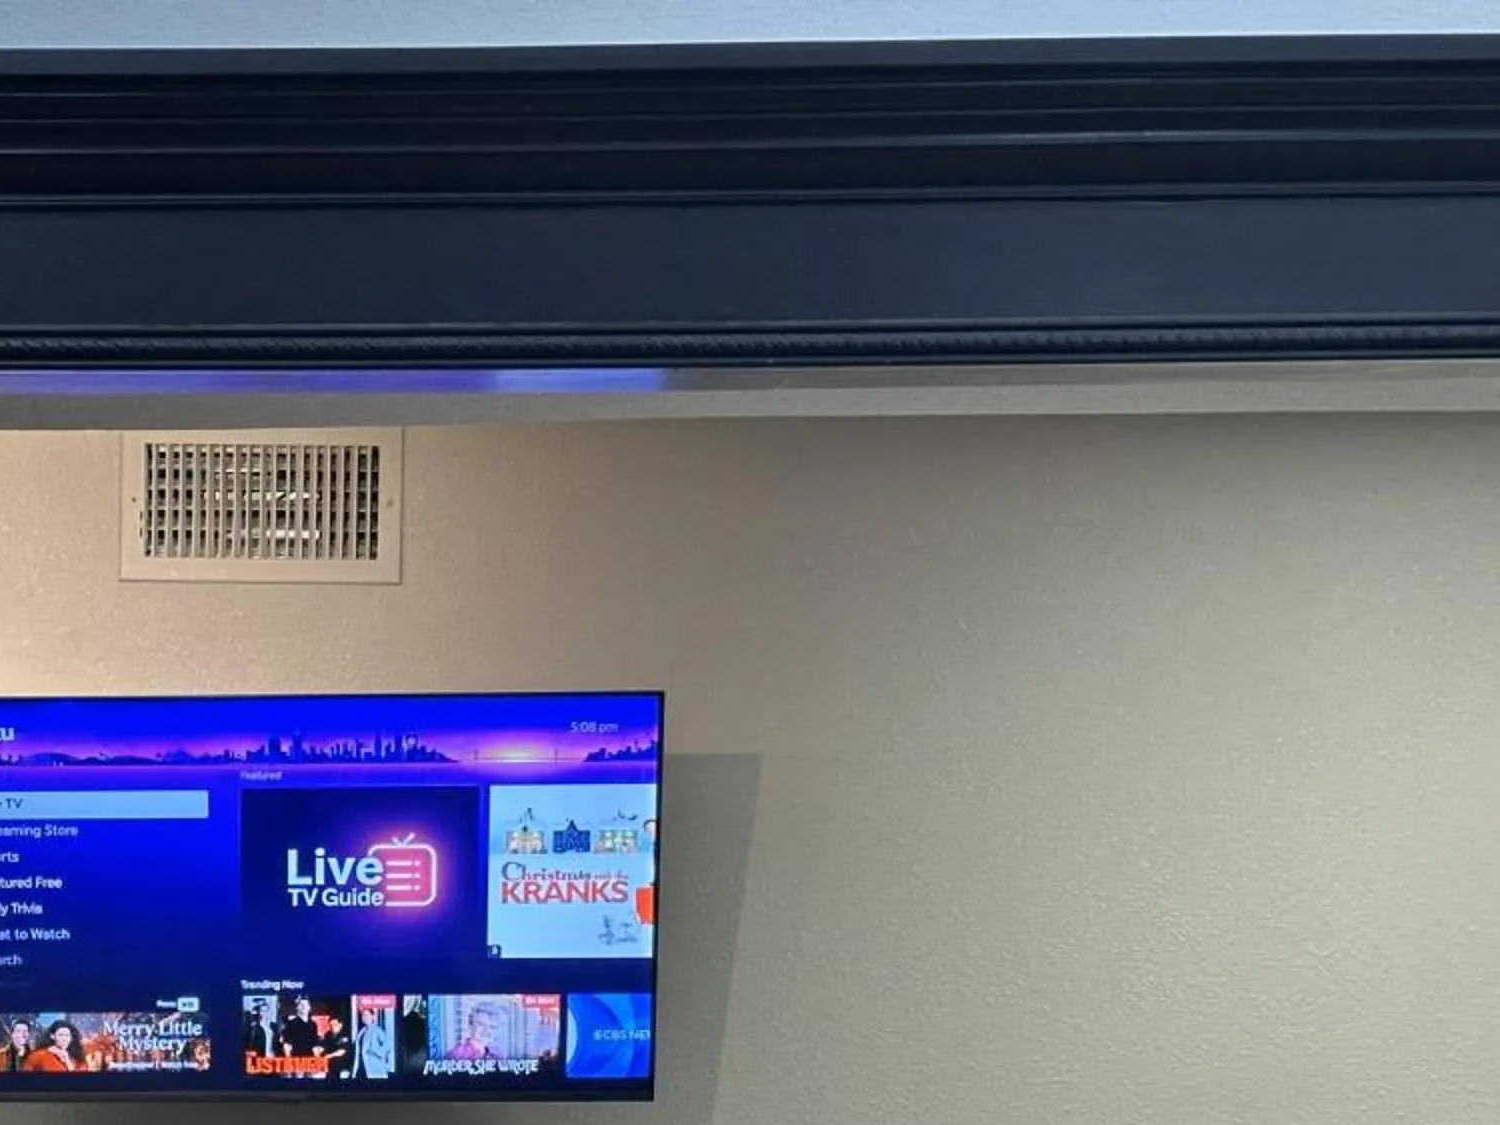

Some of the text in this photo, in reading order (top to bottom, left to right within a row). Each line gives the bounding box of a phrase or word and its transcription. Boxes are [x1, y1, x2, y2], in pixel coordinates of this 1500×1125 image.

[599, 723, 619, 734] pm
[6, 798, 23, 809] TV
[44, 824, 79, 837] Store
[287, 848, 384, 885] Live
[502, 862, 591, 881] Christmas
[35, 876, 63, 889] Free
[288, 888, 384, 907] TV Guide
[502, 881, 629, 904] KRANKS
[11, 902, 43, 915] Trivia
[15, 928, 28, 940] to
[30, 928, 71, 940] Watch
[241, 980, 304, 990] Trending Now
[104, 1020, 203, 1038] Merry Little
[119, 1037, 187, 1055] Mystery
